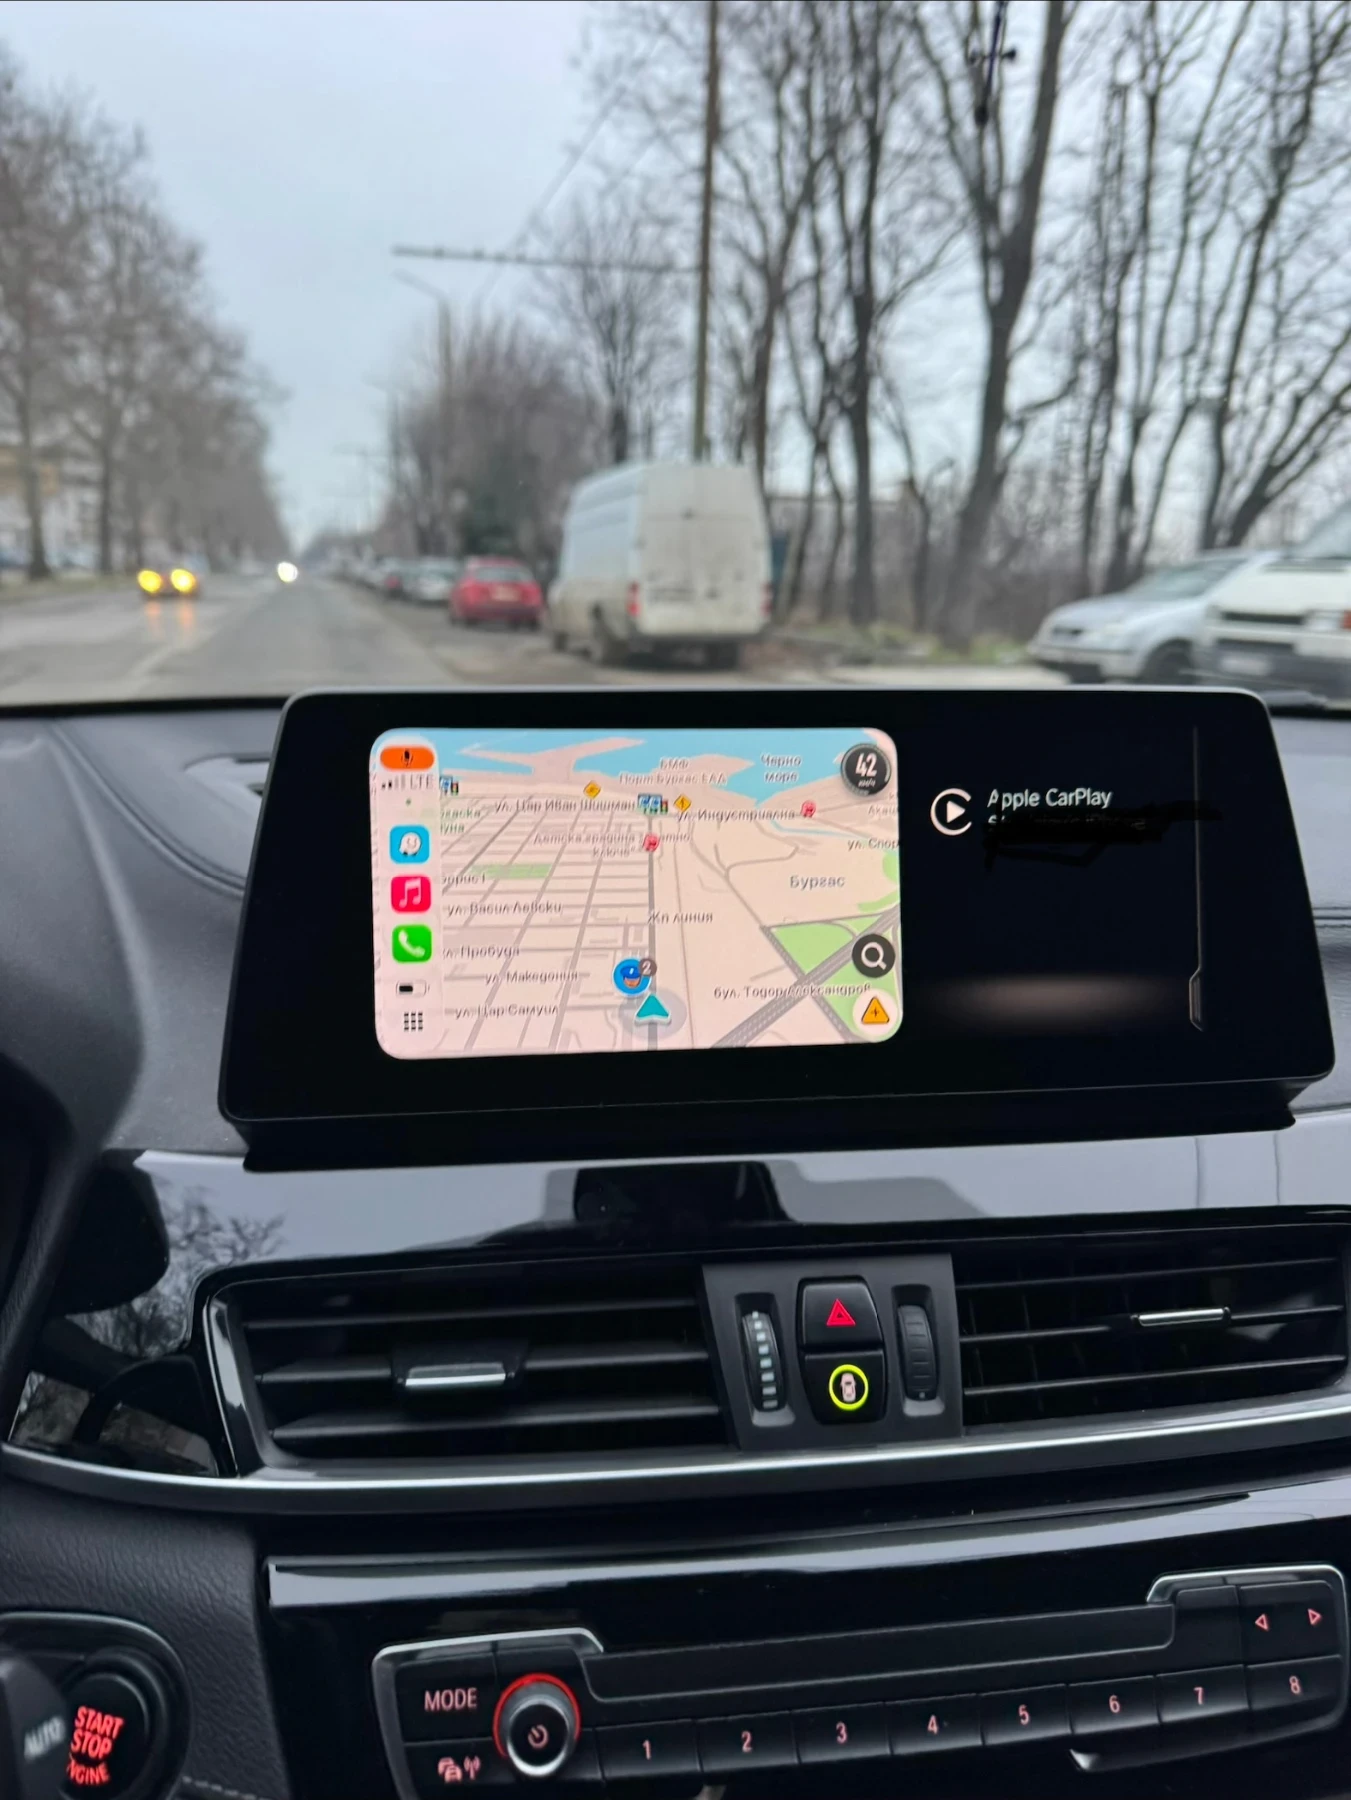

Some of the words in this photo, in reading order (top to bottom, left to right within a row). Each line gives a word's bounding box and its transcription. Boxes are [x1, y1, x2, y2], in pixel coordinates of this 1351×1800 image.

[760, 753, 802, 768] Черно
[855, 752, 878, 777] 42
[410, 774, 433, 789] LTE
[764, 771, 799, 784] море
[516, 799, 542, 813] Цар
[545, 799, 577, 812] Иван
[580, 799, 635, 812] Шишман
[987, 788, 1040, 811] Apple
[1045, 787, 1112, 809] CarPlay
[697, 808, 795, 824] Индустриална
[790, 874, 846, 891] Бургас
[469, 902, 511, 916] Васил
[513, 900, 562, 915] Левски
[647, 910, 669, 924] Жп
[672, 911, 713, 924] линия
[460, 945, 520, 960] Пробуда
[642, 960, 652, 975] 2
[506, 970, 578, 984] Македония
[713, 986, 741, 1000] бул.
[744, 984, 783, 999] Тодор
[477, 1004, 505, 1019] Цар
[508, 1003, 559, 1018] Самуил
[1290, 1675, 1300, 1694] 8
[424, 1688, 477, 1711] MODE
[1110, 1694, 1120, 1713] 6
[1194, 1686, 1203, 1705] 7
[74, 1705, 124, 1740] START
[1019, 1705, 1029, 1724] 5
[837, 1722, 847, 1743] 3
[928, 1715, 938, 1733] 4
[71, 1729, 112, 1759] STOP
[643, 1740, 651, 1758] 1
[741, 1731, 752, 1752] 2
[66, 1758, 110, 1786] NGINE
